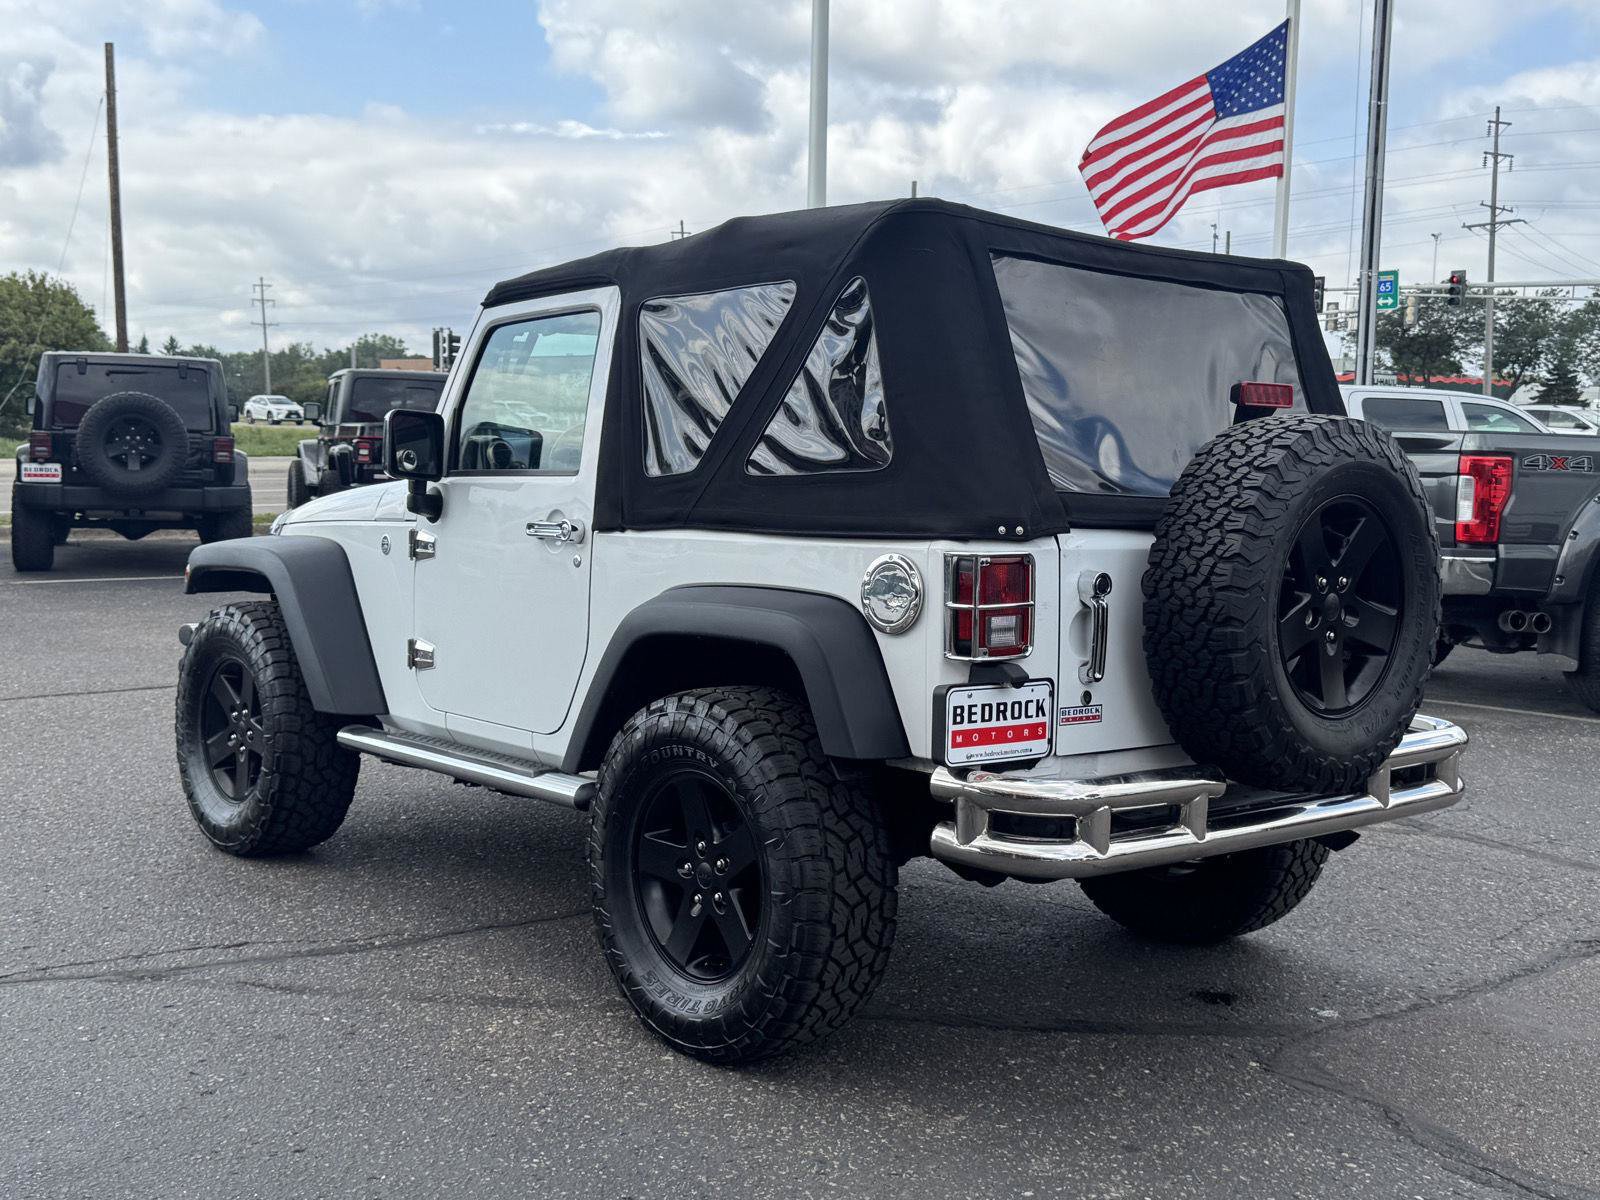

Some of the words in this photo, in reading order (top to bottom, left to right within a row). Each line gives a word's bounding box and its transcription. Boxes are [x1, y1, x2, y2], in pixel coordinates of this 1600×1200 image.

[1380, 282, 1391, 292] 65
[952, 698, 1047, 726] BEDROCK
[1061, 707, 1100, 717] BEDROCK
[956, 727, 1043, 742] MOTORS
